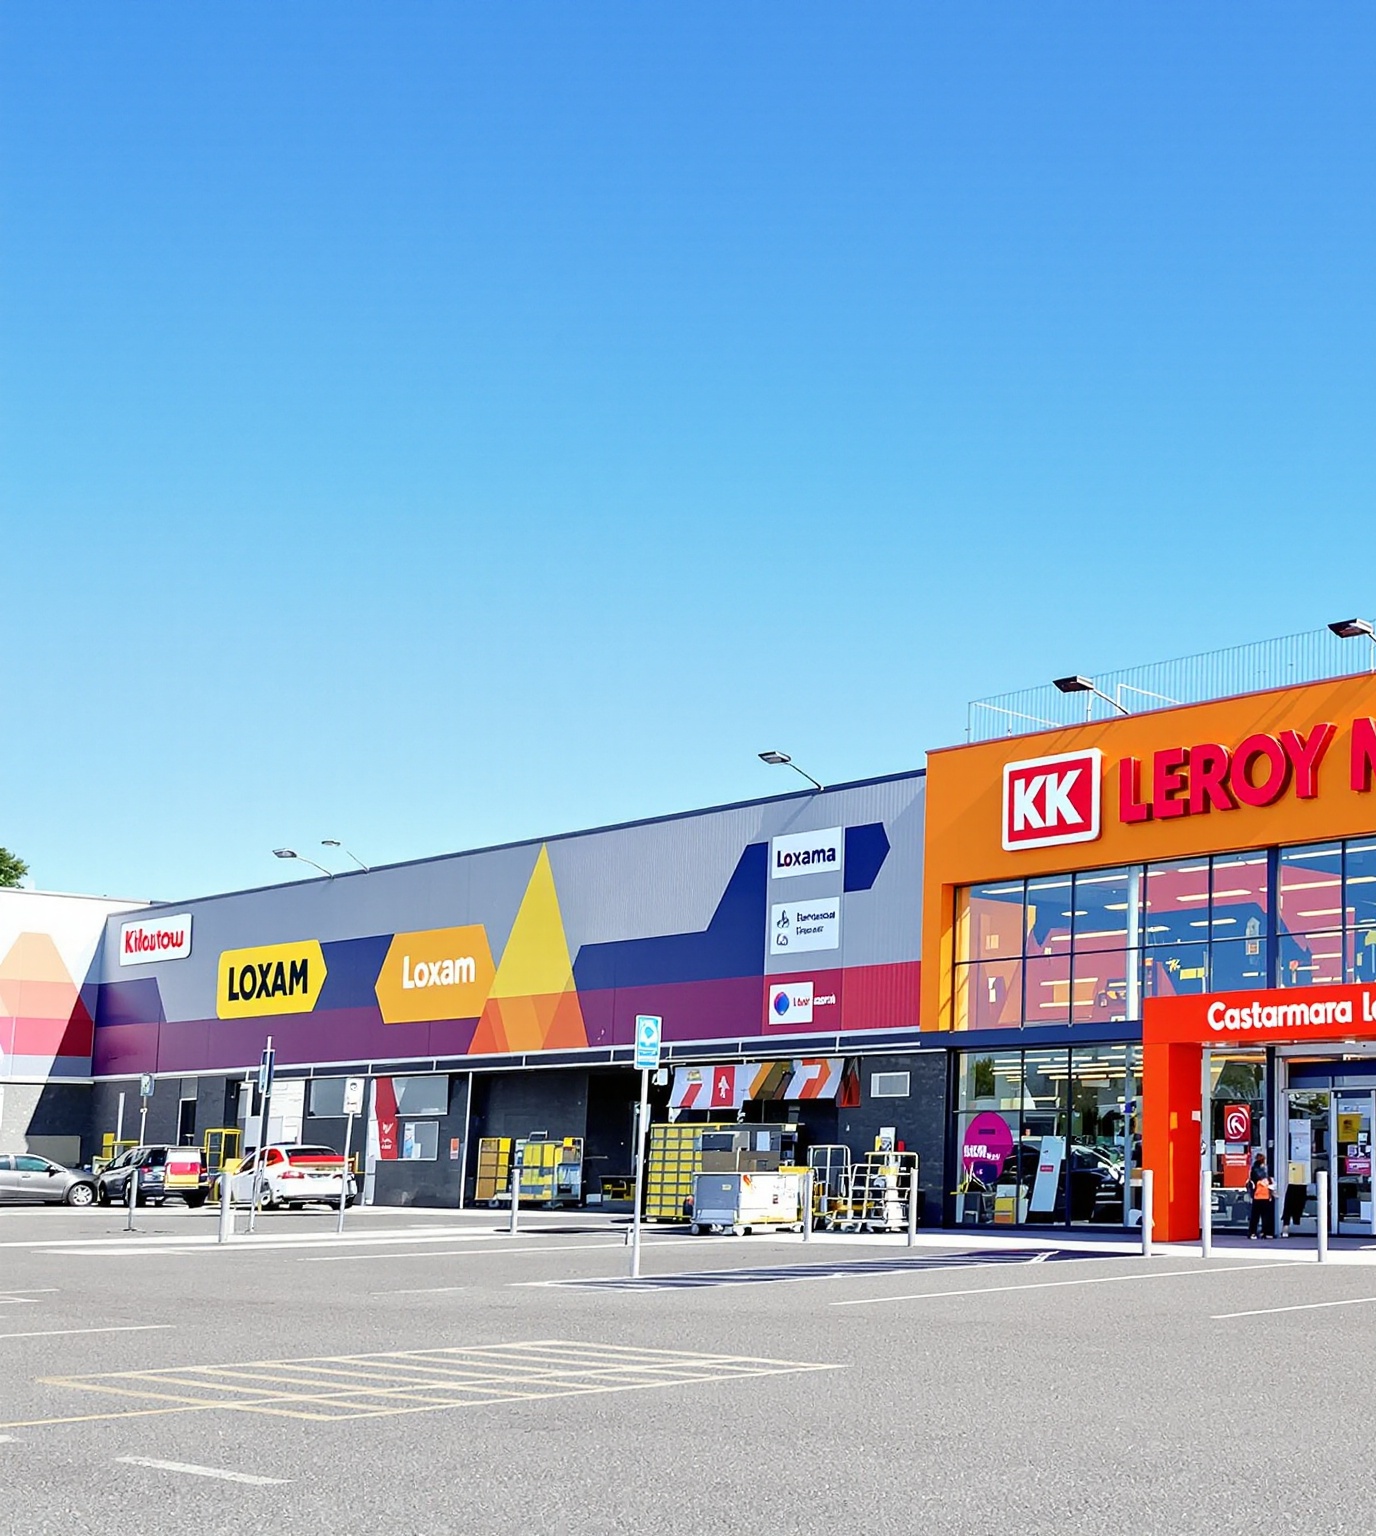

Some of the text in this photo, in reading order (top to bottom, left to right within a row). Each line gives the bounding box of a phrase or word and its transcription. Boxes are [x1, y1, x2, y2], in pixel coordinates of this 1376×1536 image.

[1119, 723, 1336, 824] LEROY
[1013, 769, 1083, 832] KK
[777, 847, 836, 868] Loxama
[228, 959, 307, 1001] LOXAM
[403, 956, 475, 989] Loxam
